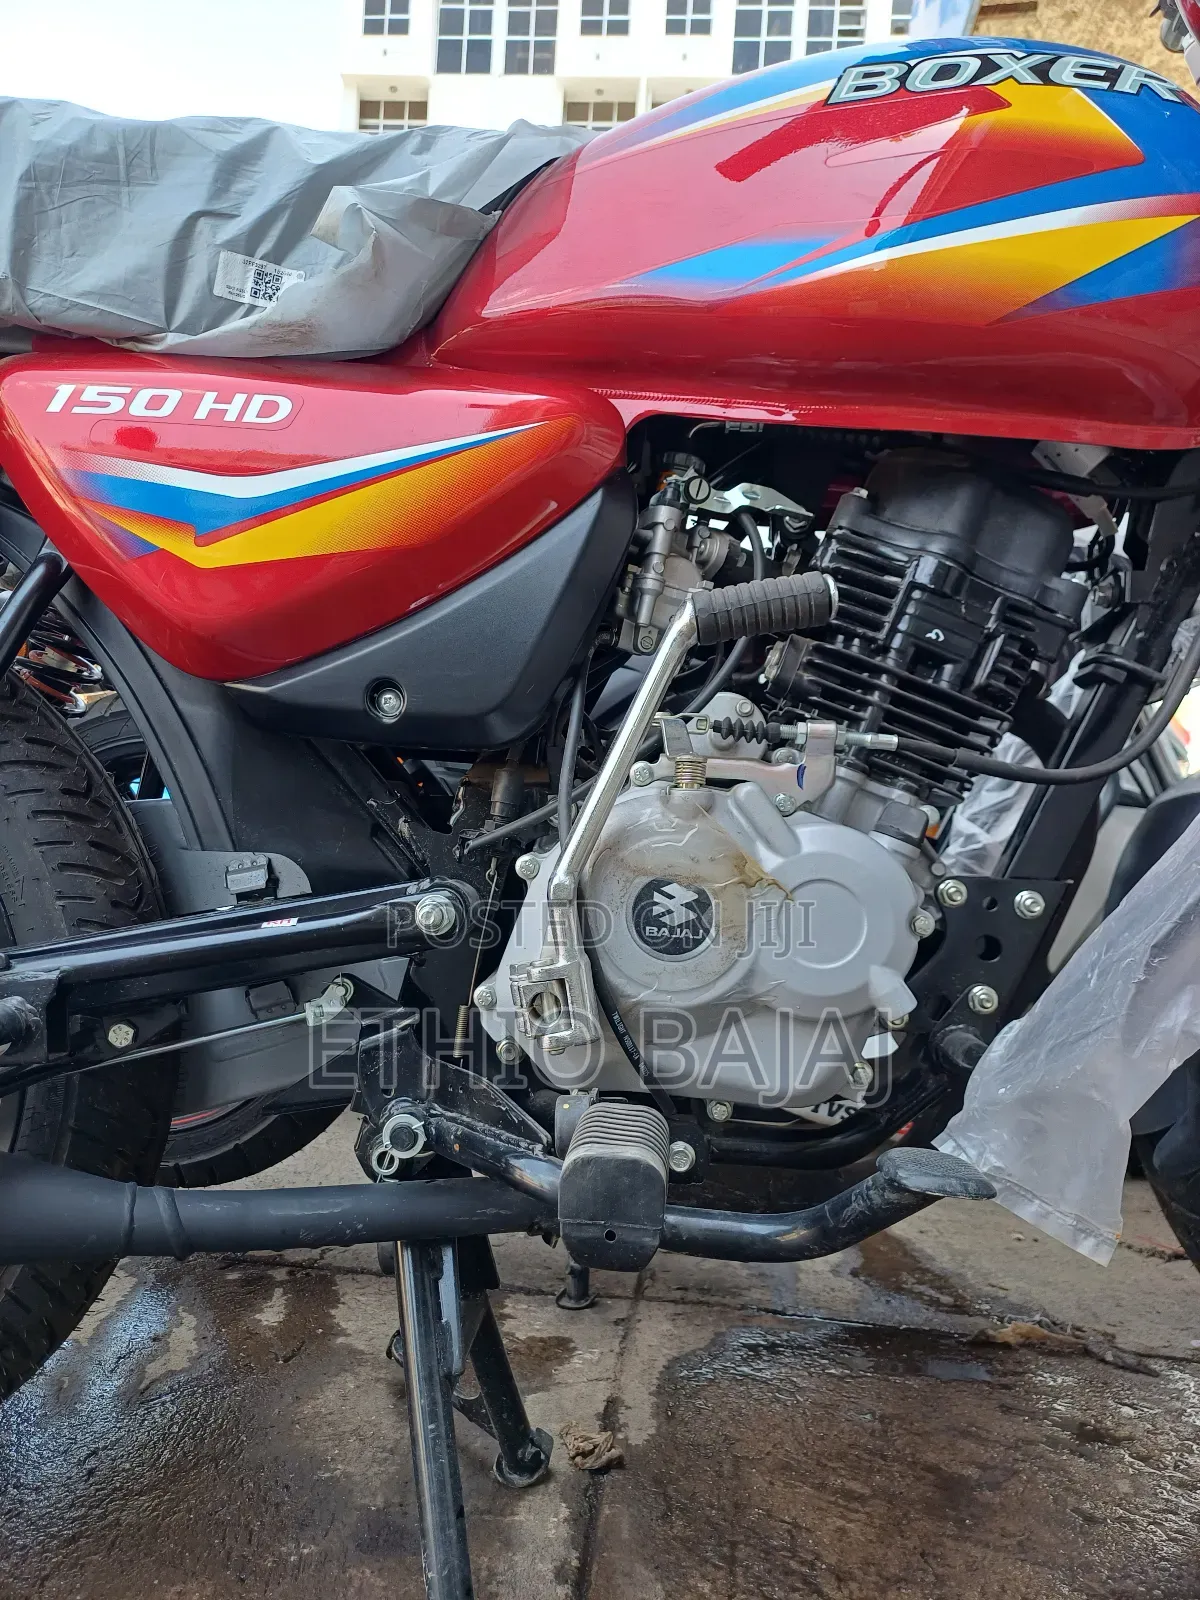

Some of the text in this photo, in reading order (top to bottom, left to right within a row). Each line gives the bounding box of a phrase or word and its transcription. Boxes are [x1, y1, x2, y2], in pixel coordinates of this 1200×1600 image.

[824, 52, 1184, 105] BOXER
[45, 384, 293, 424] 150 HD
[645, 926, 704, 939] BAJAJ
